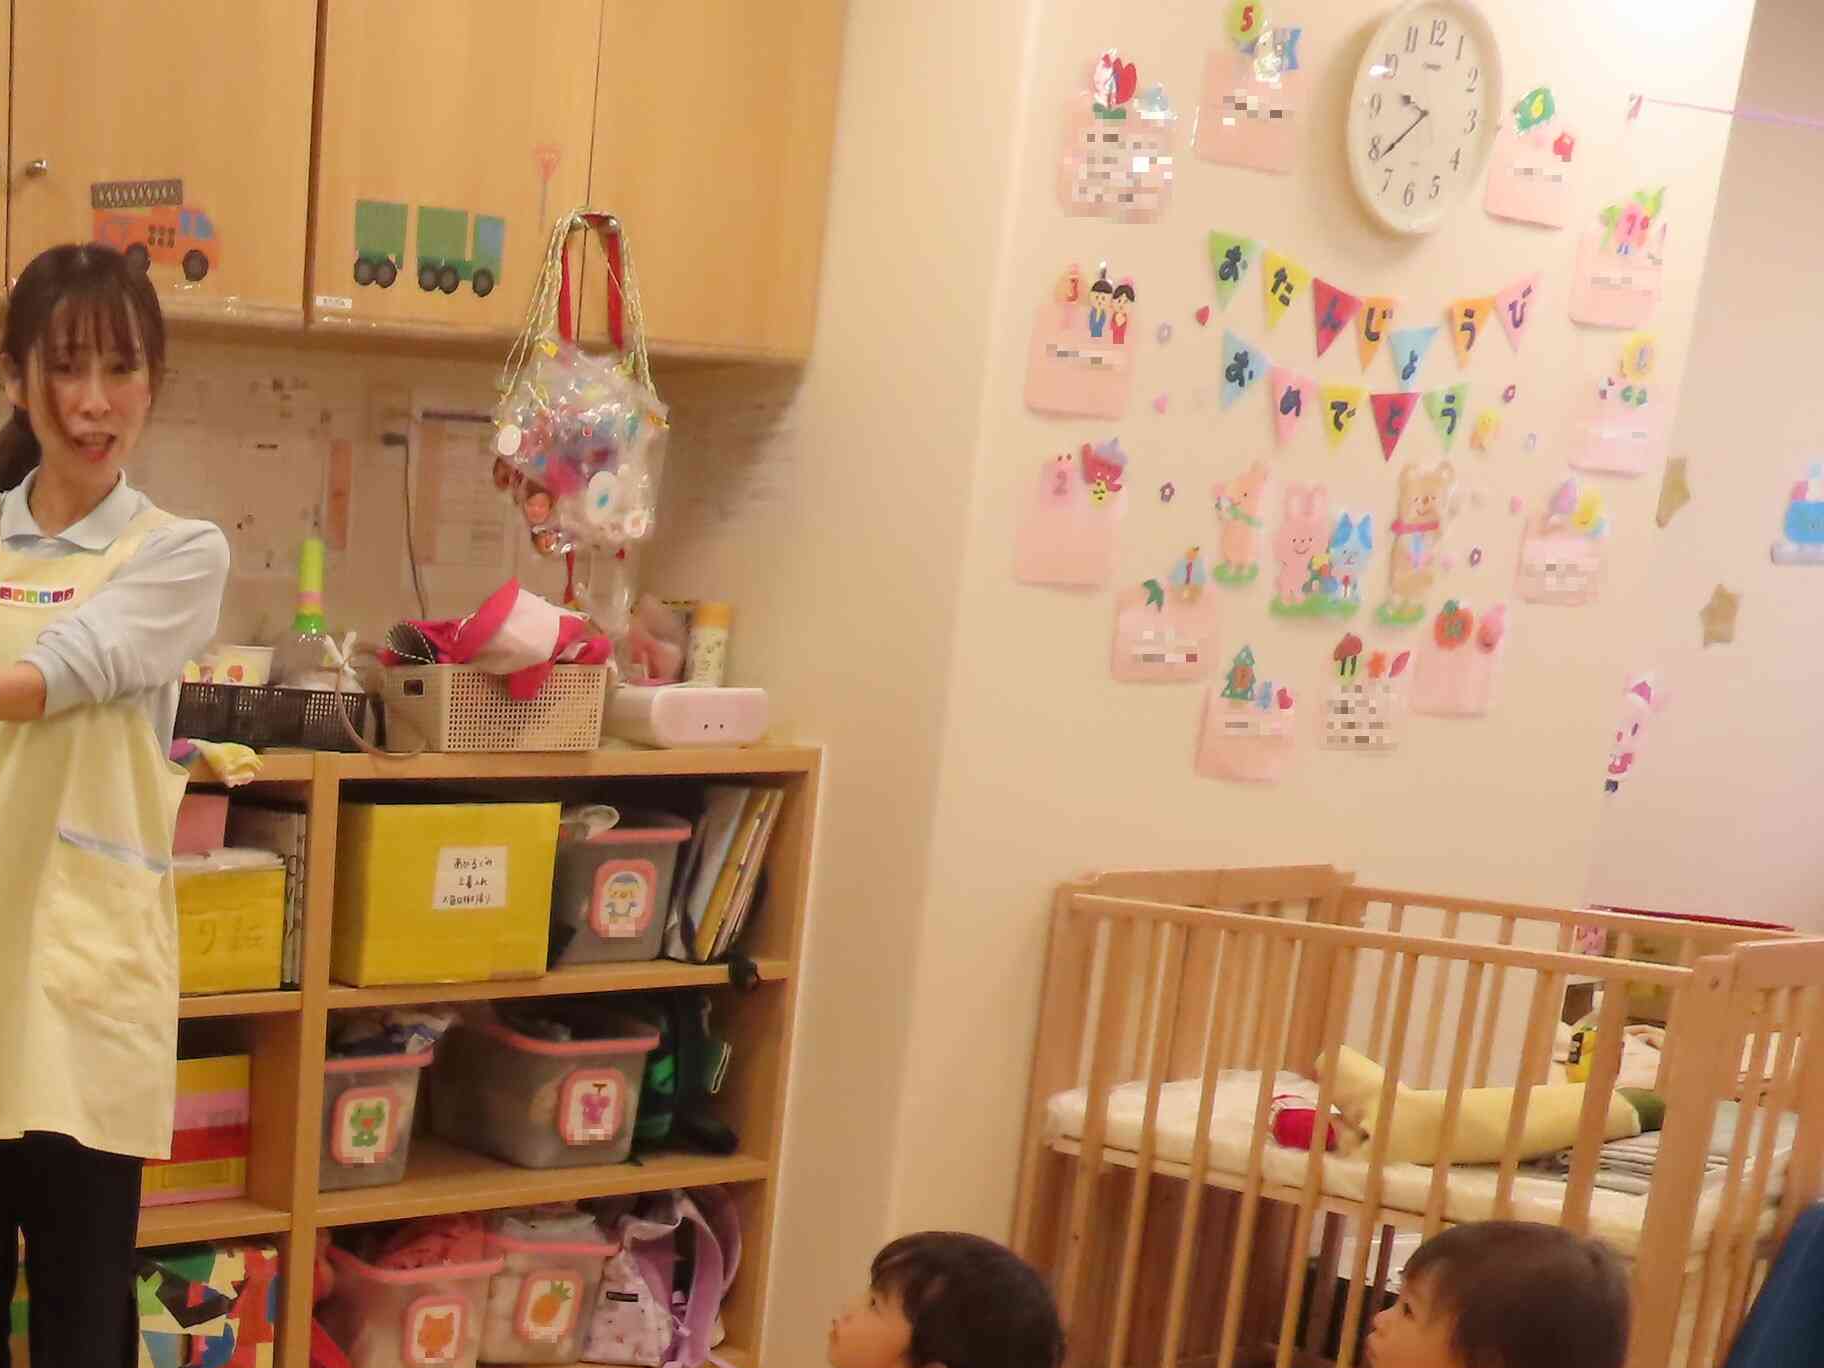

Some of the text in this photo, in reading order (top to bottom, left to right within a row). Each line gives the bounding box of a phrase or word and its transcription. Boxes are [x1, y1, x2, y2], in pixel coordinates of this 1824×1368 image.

[1239, 6, 1254, 32] 5
[1405, 26, 1419, 53] 11
[1430, 19, 1448, 46] 12
[1456, 34, 1465, 61] 1
[1466, 66, 1478, 93] 2
[1368, 93, 1382, 119] 9
[1463, 109, 1477, 134] 3
[1367, 136, 1380, 160] 8
[1449, 147, 1461, 171] 4
[1381, 168, 1395, 193] 7
[1428, 175, 1441, 200] 5
[1403, 181, 1415, 207] 6
